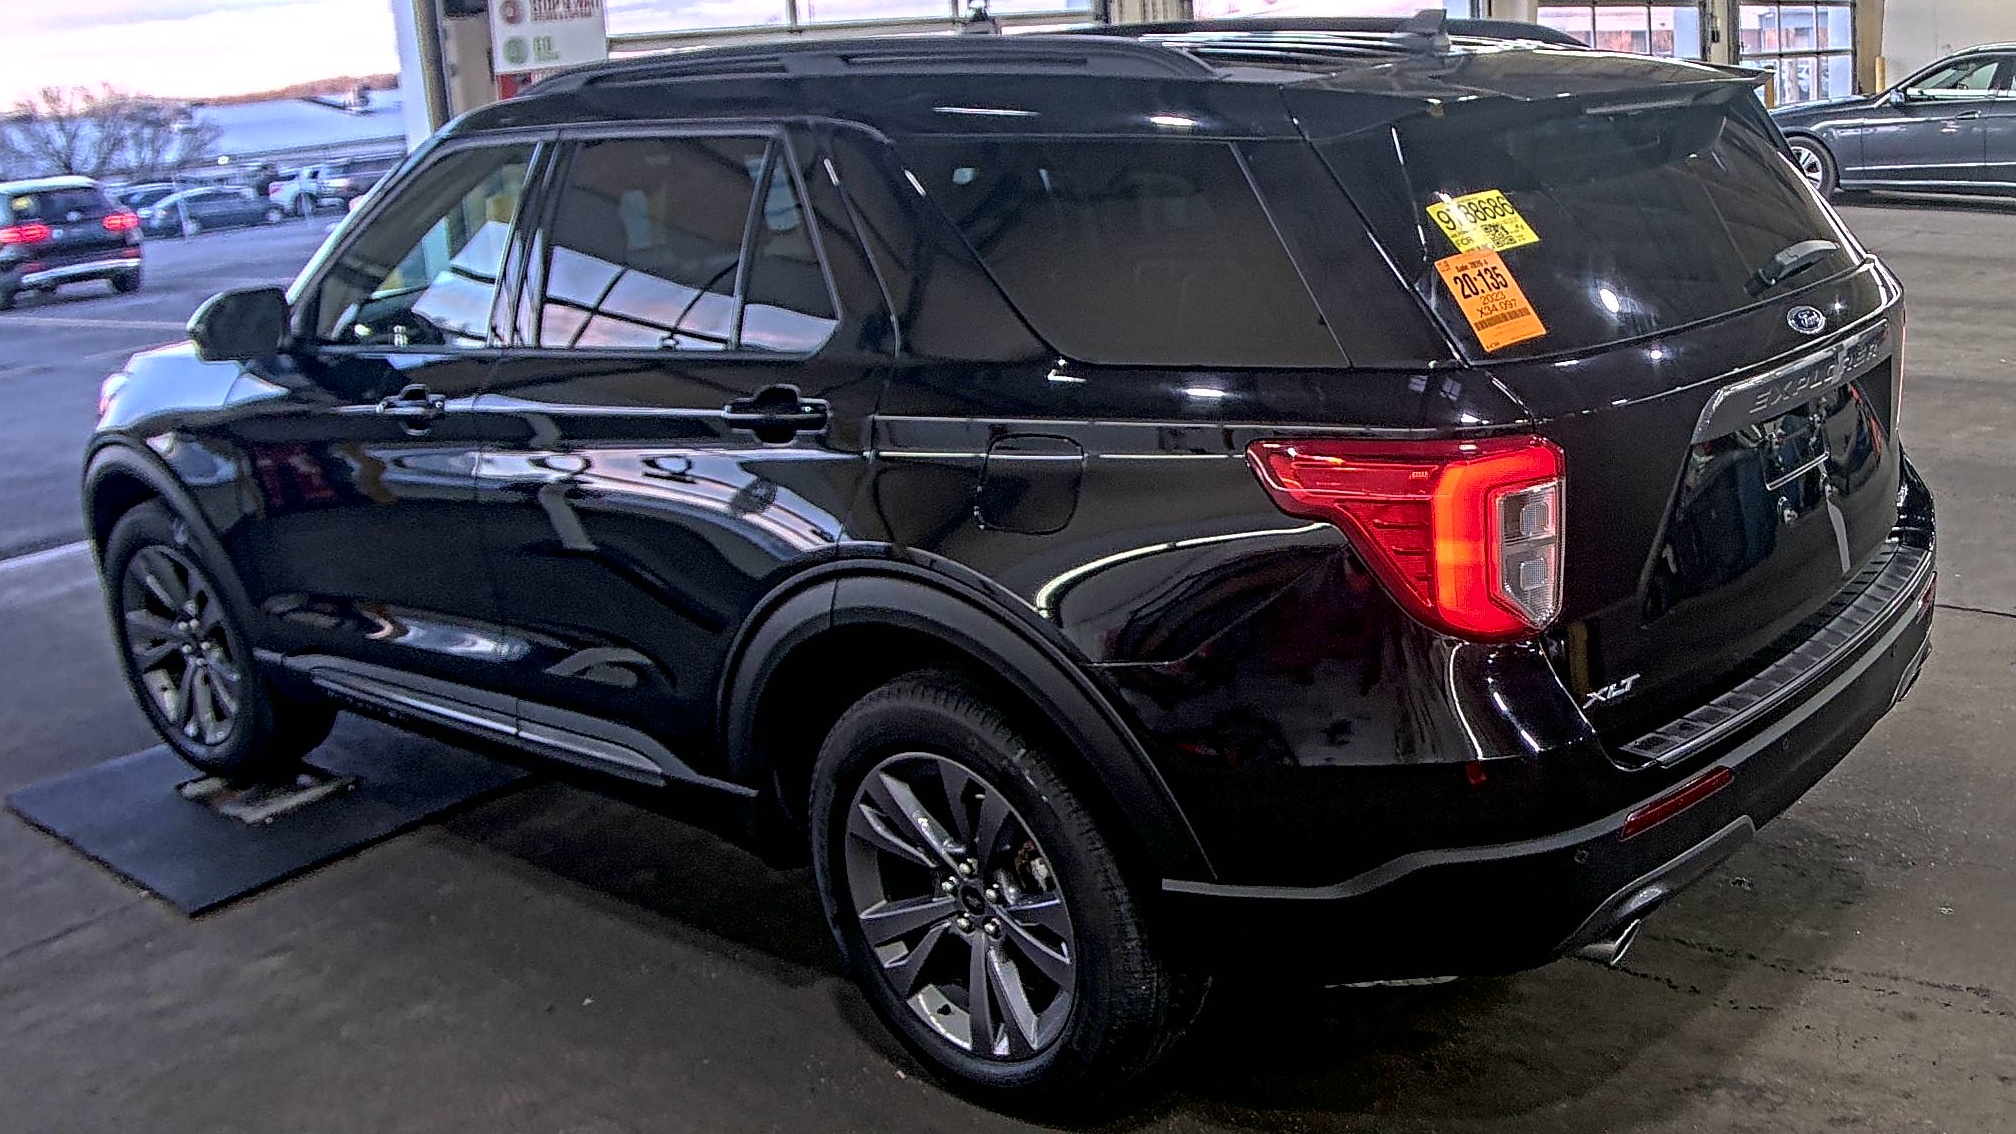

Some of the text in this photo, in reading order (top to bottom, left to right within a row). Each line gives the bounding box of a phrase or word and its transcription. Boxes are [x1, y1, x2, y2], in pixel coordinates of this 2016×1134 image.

[1453, 265, 1509, 299] 20:135
[1480, 291, 1506, 305] 2023
[1499, 299, 1518, 311] 097
[1749, 343, 1879, 414] EXPLORER
[1583, 673, 1640, 709] XLT
